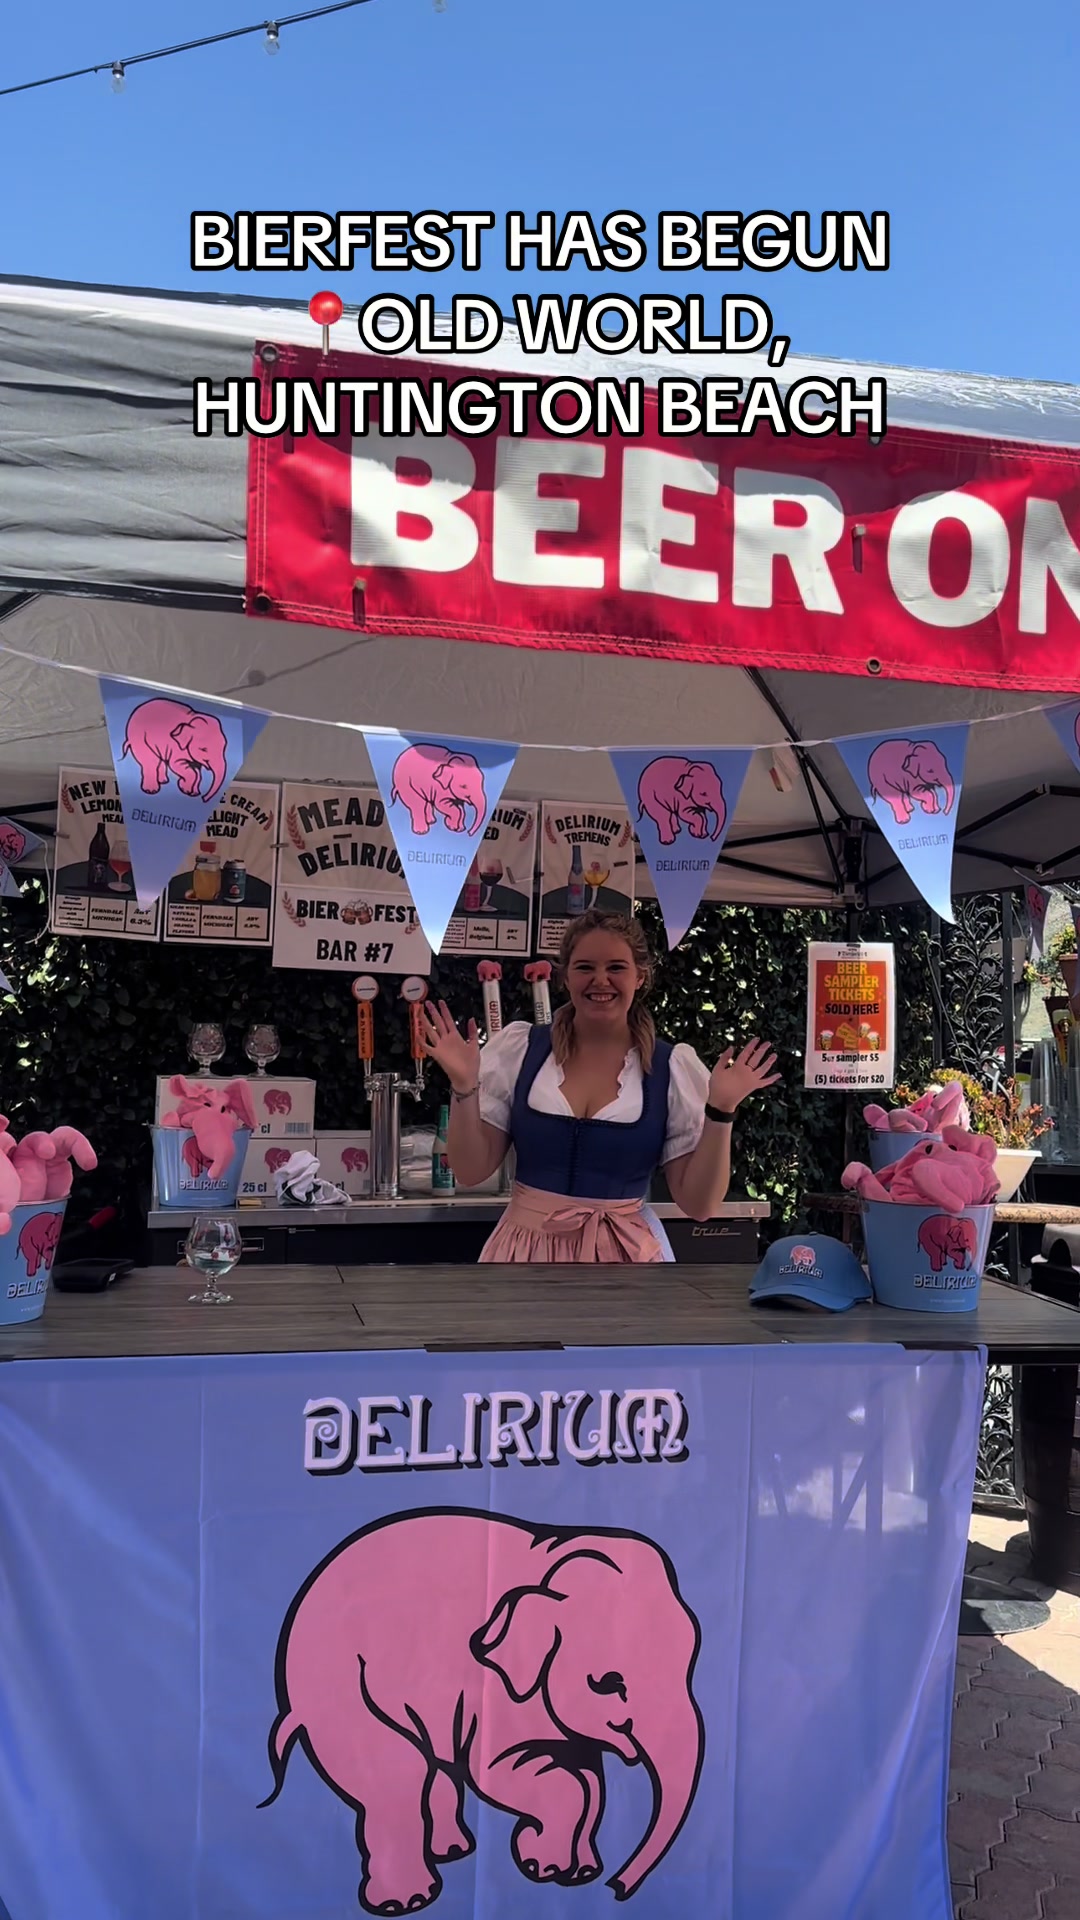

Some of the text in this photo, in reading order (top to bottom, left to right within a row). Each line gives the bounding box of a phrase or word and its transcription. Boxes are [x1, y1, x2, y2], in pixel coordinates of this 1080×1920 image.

[350, 421, 844, 615] BEER
[68, 780, 106, 801] NEW
[231, 794, 268, 825] CREAM
[297, 797, 385, 833] MEAD
[102, 813, 124, 824] MEA
[131, 808, 197, 833] DELIRIUM
[207, 810, 248, 827] LIGHT
[555, 815, 621, 836] DELIRIUM
[206, 825, 238, 838] MEAD
[564, 831, 611, 847] TREMENS
[898, 833, 949, 850] DELIRIUM
[297, 842, 405, 879] DELIRIU
[407, 850, 467, 867] DELIRIUM
[656, 860, 710, 872] DELIRIUM
[296, 900, 416, 923] BIER FEST
[316, 939, 394, 963] BAR #7
[837, 962, 868, 975] BEER
[824, 975, 879, 988] SAMPLER
[829, 988, 875, 1001] TICKETS
[824, 1003, 879, 1015] SOLD HERE
[836, 1053, 868, 1064] sampler
[870, 1053, 879, 1062] $5
[814, 1074, 885, 1085] (5) tickets for $20
[243, 1182, 267, 1193] 25 cl
[302, 1387, 691, 1478] DELIRIUM
